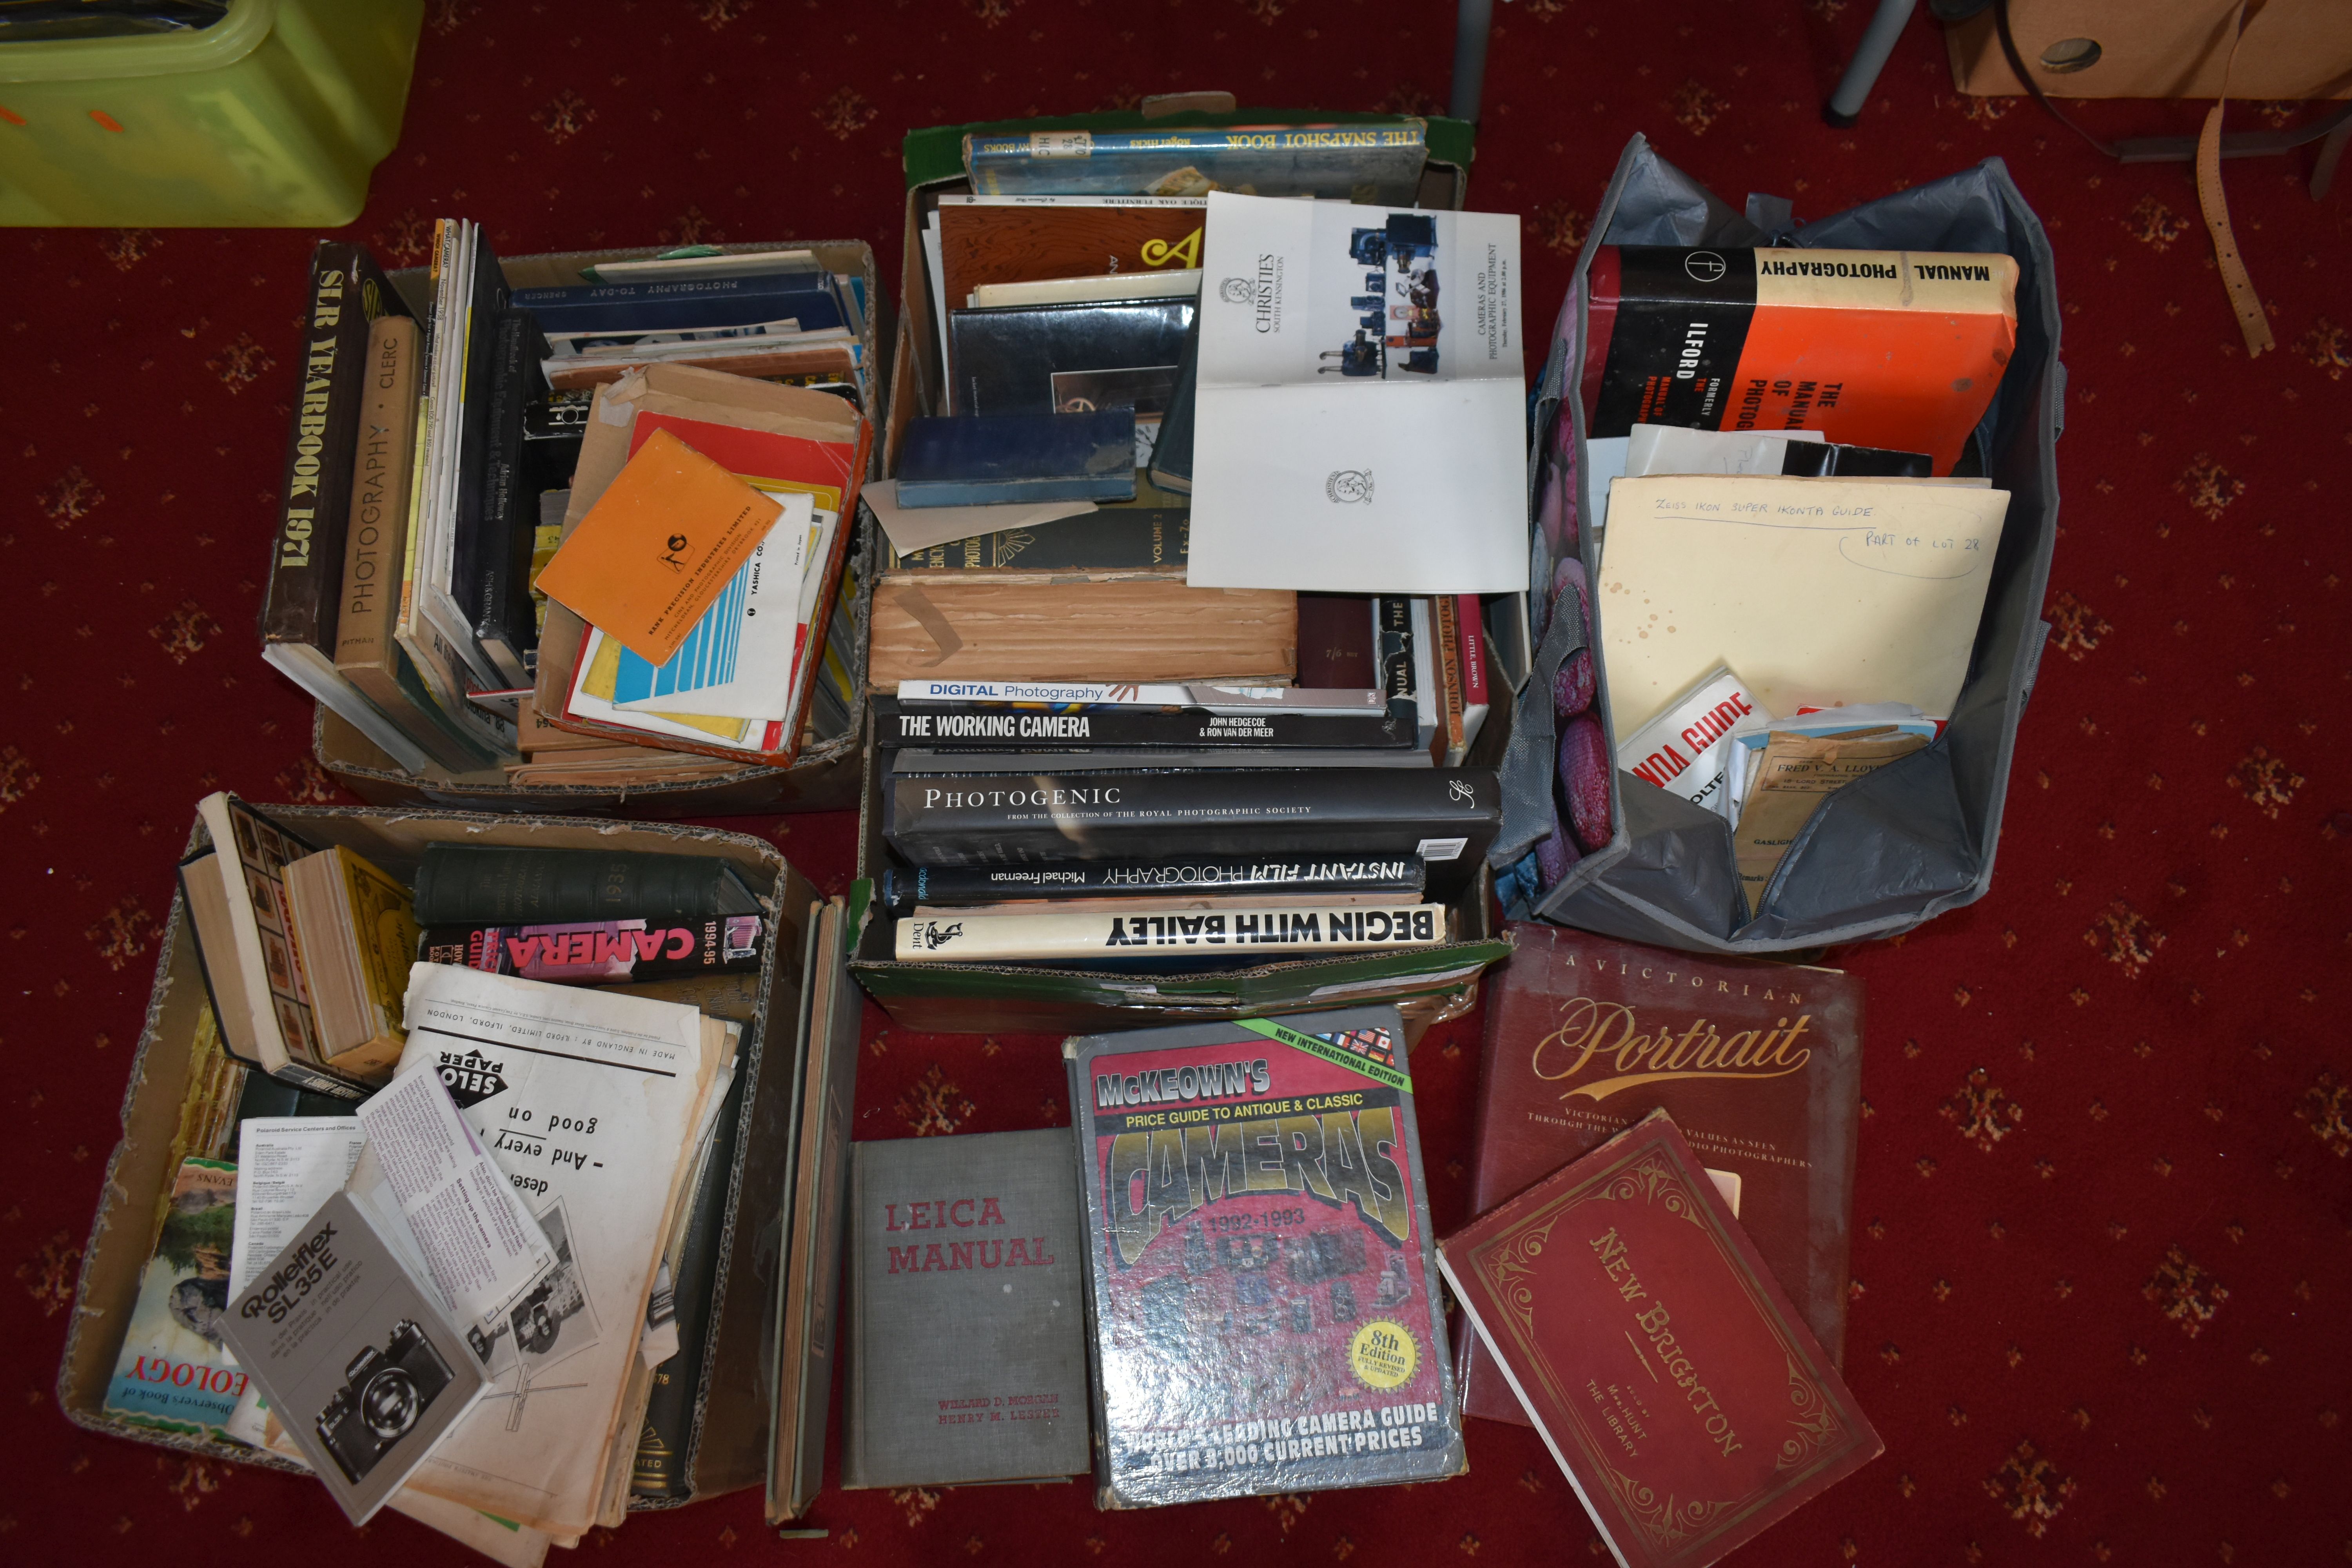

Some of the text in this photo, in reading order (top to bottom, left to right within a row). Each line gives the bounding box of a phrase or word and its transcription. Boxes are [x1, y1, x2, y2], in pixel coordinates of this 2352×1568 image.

[1039, 138, 1049, 155] HIC
[1130, 136, 1191, 147] Roger Hicks
[1227, 130, 1421, 150] THE SNAPSHOT BOOK
[1275, 256, 1284, 304] KENSINGTON
[1761, 261, 1990, 281] MANUAL PHOTOGRAPHY
[524, 281, 737, 299] PHOTOGRAPHY TO-DAY SPENCER
[1256, 254, 1274, 333] CHRISTIE'S
[1488, 243, 1497, 360] PHOTOGRAPHIC EQUIPMENT
[1676, 323, 1708, 379] ILFORD
[1655, 377, 1671, 405] MANUAL
[1694, 378, 1707, 392] THE
[1701, 378, 1720, 417] FORMERLY
[1772, 381, 1792, 397] OF
[1817, 383, 1843, 408] THE
[281, 270, 344, 568] SLR YEARBOOK 1971
[352, 338, 397, 614] PHOTOGRAPHY CLERC
[1655, 499, 1872, 517] ZEISS IKON SUPER IKONTA GUIDE
[1153, 522, 1162, 563] VOLUME
[1866, 531, 1979, 551] PART LOT 28
[648, 617, 664, 635] RANK
[664, 578, 695, 615] PRECISION
[695, 536, 727, 576] INDUSTRIES
[727, 506, 751, 535] LIMITED
[751, 562, 761, 595] YASHICA
[1393, 603, 1403, 626] THE
[1444, 657, 1459, 715] JOHNSON
[1470, 661, 1479, 688] BROWN
[930, 684, 1103, 701] DIGITAL Photography
[899, 715, 1090, 737] THE WORKING CAMERA
[1200, 728, 1274, 737] & RON VAN DER MEER
[1209, 717, 1266, 727] JOHN HEDGECOE
[1777, 764, 1810, 773] FRED
[1829, 764, 1838, 773] A.
[1051, 811, 1100, 819] COLLECTION
[1178, 807, 1261, 816] PHOTOGRAPHIC
[606, 863, 626, 903] 1935
[991, 871, 1085, 884] Michael Freeman
[1103, 861, 1406, 884] INSTANT FILM PHOTOGRAPHY
[704, 920, 716, 965] 1994-95
[912, 921, 924, 950] Dent
[1105, 910, 1434, 947] BEGIN WITH BAILEY
[506, 928, 695, 968] CAMERA
[1566, 955, 1802, 1004] A VICTORIAN
[426, 1009, 463, 1022] LONDON
[545, 1032, 571, 1043] ILFORD
[597, 1040, 635, 1054] ENGLAND
[1533, 997, 1811, 1084] Portrait
[440, 1051, 504, 1075] PAPER
[657, 1051, 676, 1060] MADE
[1275, 1028, 1405, 1087] NEW INTERNATIONAL EDITION
[444, 1066, 498, 1094] SELO
[509, 1105, 598, 1134] good on
[1126, 1093, 1363, 1128] PRICE GUIDE TO ANTIQUE & CLASSIC
[1528, 1112, 1813, 1168] THROUGH PHOTOGRAPHERS
[1565, 1108, 1627, 1125] VICTORIAN
[1686, 1129, 1728, 1143] VALUES
[1748, 1140, 1776, 1151] SEEN
[494, 1132, 588, 1171] And every
[196, 1174, 233, 1185] EVANS
[1111, 1107, 1410, 1265] CAMERAS
[454, 1178, 492, 1248] Setting camera
[494, 1196, 509, 1219] tempted
[885, 1198, 1005, 1231] LEICA
[887, 1237, 1054, 1274] MANUAL
[1589, 1227, 1647, 1302] NEW
[235, 1220, 343, 1324] Rolleiflex
[1360, 1343, 1405, 1365] Edition
[1371, 1330, 1399, 1351] 8th
[1358, 1356, 1405, 1373] FULLY REVISED
[1370, 1366, 1398, 1377] UPDATED
[122, 1386, 169, 1405] Book of
[938, 1397, 991, 1410] WILLARD
[1626, 1385, 1642, 1406] SOLD
[938, 1409, 1060, 1425] HENRY LESTER
[1298, 1402, 1438, 1435] CAMERA GUIDE
[1586, 1378, 1639, 1458] THE LIBRARY
[1621, 1407, 1647, 1440] HUNT
[1151, 1426, 1423, 1472] OVER CURRENT PRICES
